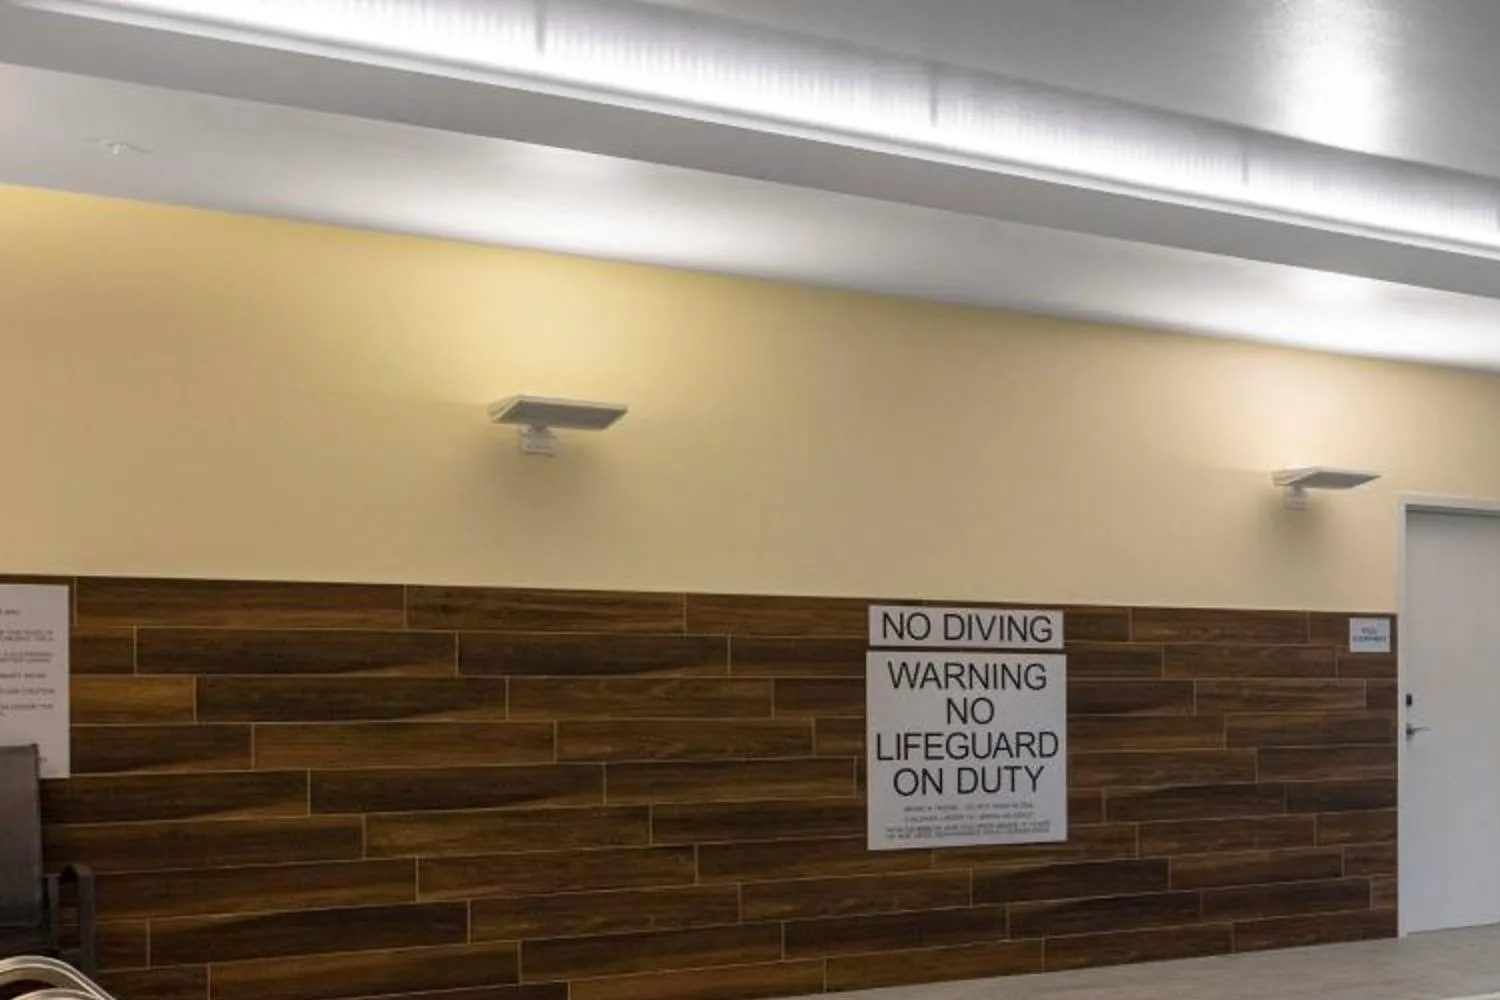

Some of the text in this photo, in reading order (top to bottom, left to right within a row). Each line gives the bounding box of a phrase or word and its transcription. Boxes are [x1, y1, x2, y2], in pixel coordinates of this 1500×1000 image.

[882, 612, 1053, 643] NO DIVING
[887, 661, 1048, 690] WARNING
[946, 697, 995, 725] NO
[876, 732, 1059, 761] LIFEGUARD
[893, 765, 1045, 796] ON DUTY
